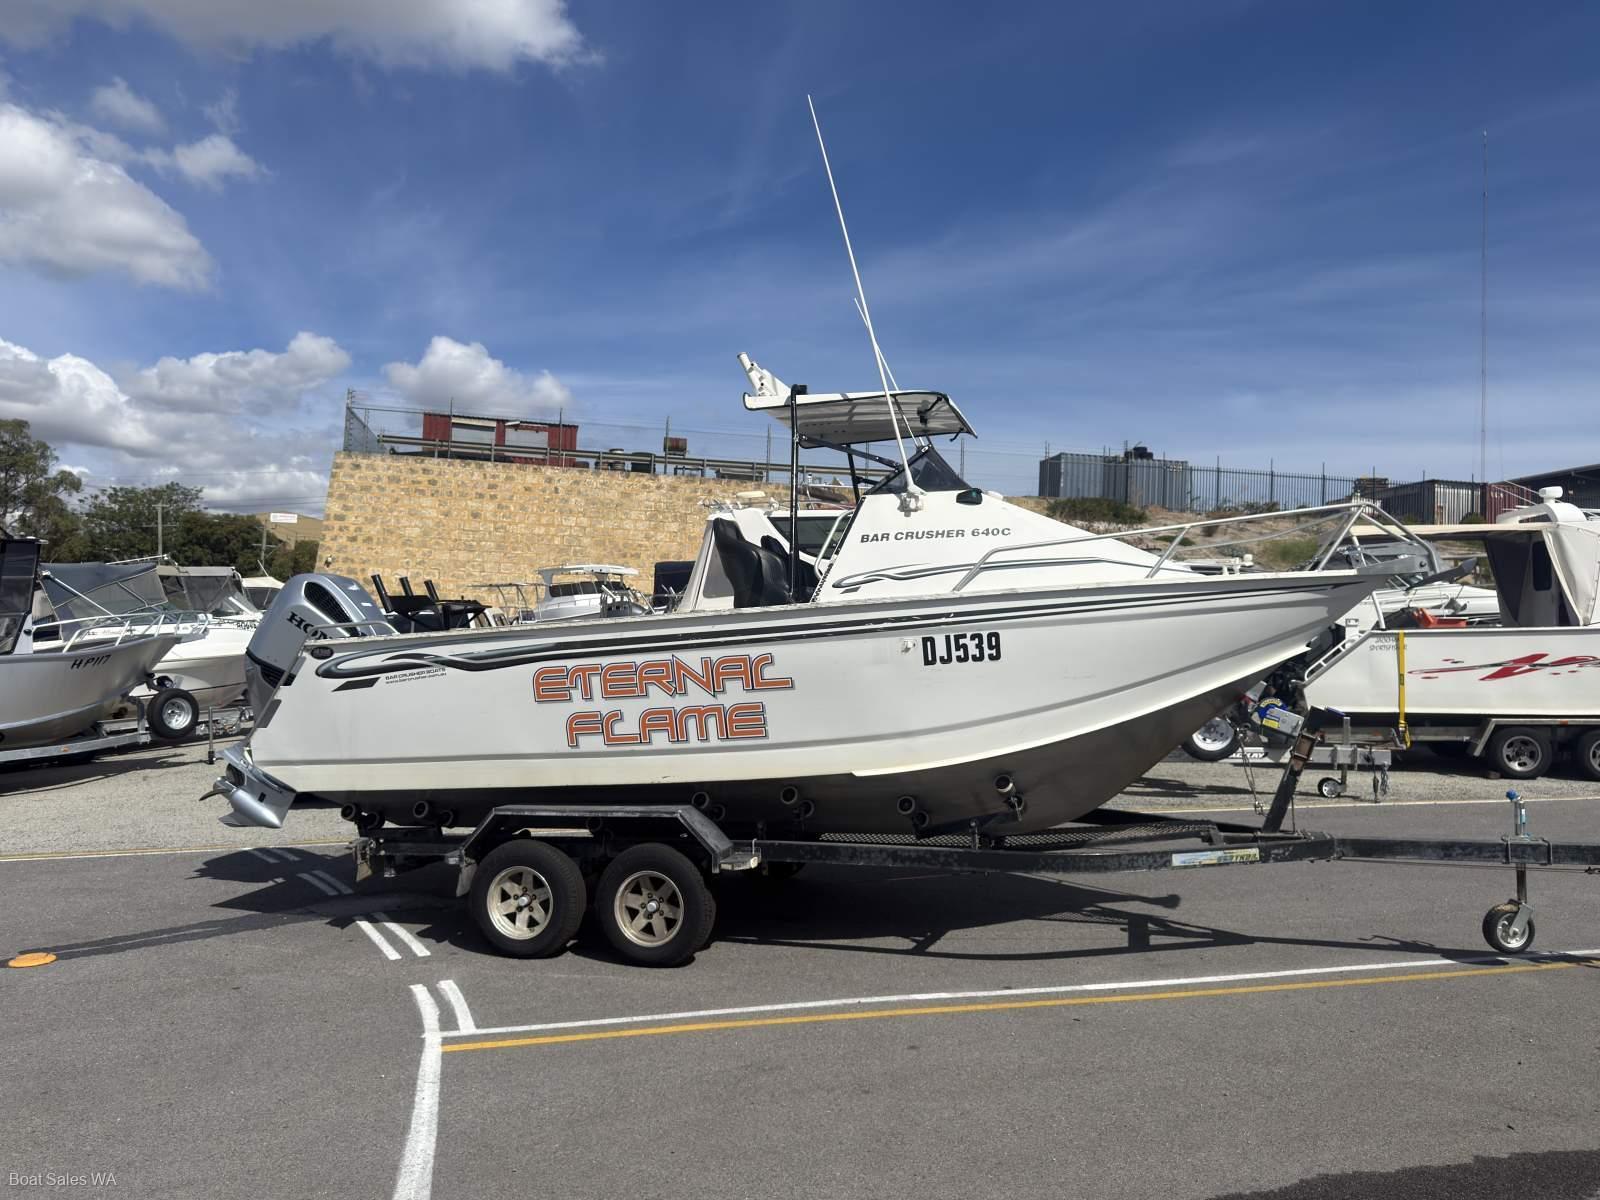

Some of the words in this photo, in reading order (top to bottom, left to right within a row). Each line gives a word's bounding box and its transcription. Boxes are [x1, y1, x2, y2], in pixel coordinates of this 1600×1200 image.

[860, 532, 890, 544] BAR
[894, 528, 965, 541] CRUSHER
[971, 527, 1012, 537] 640C
[921, 631, 1001, 667] DJ539
[532, 652, 795, 703] ETERNAL
[566, 701, 769, 749] FLAME
